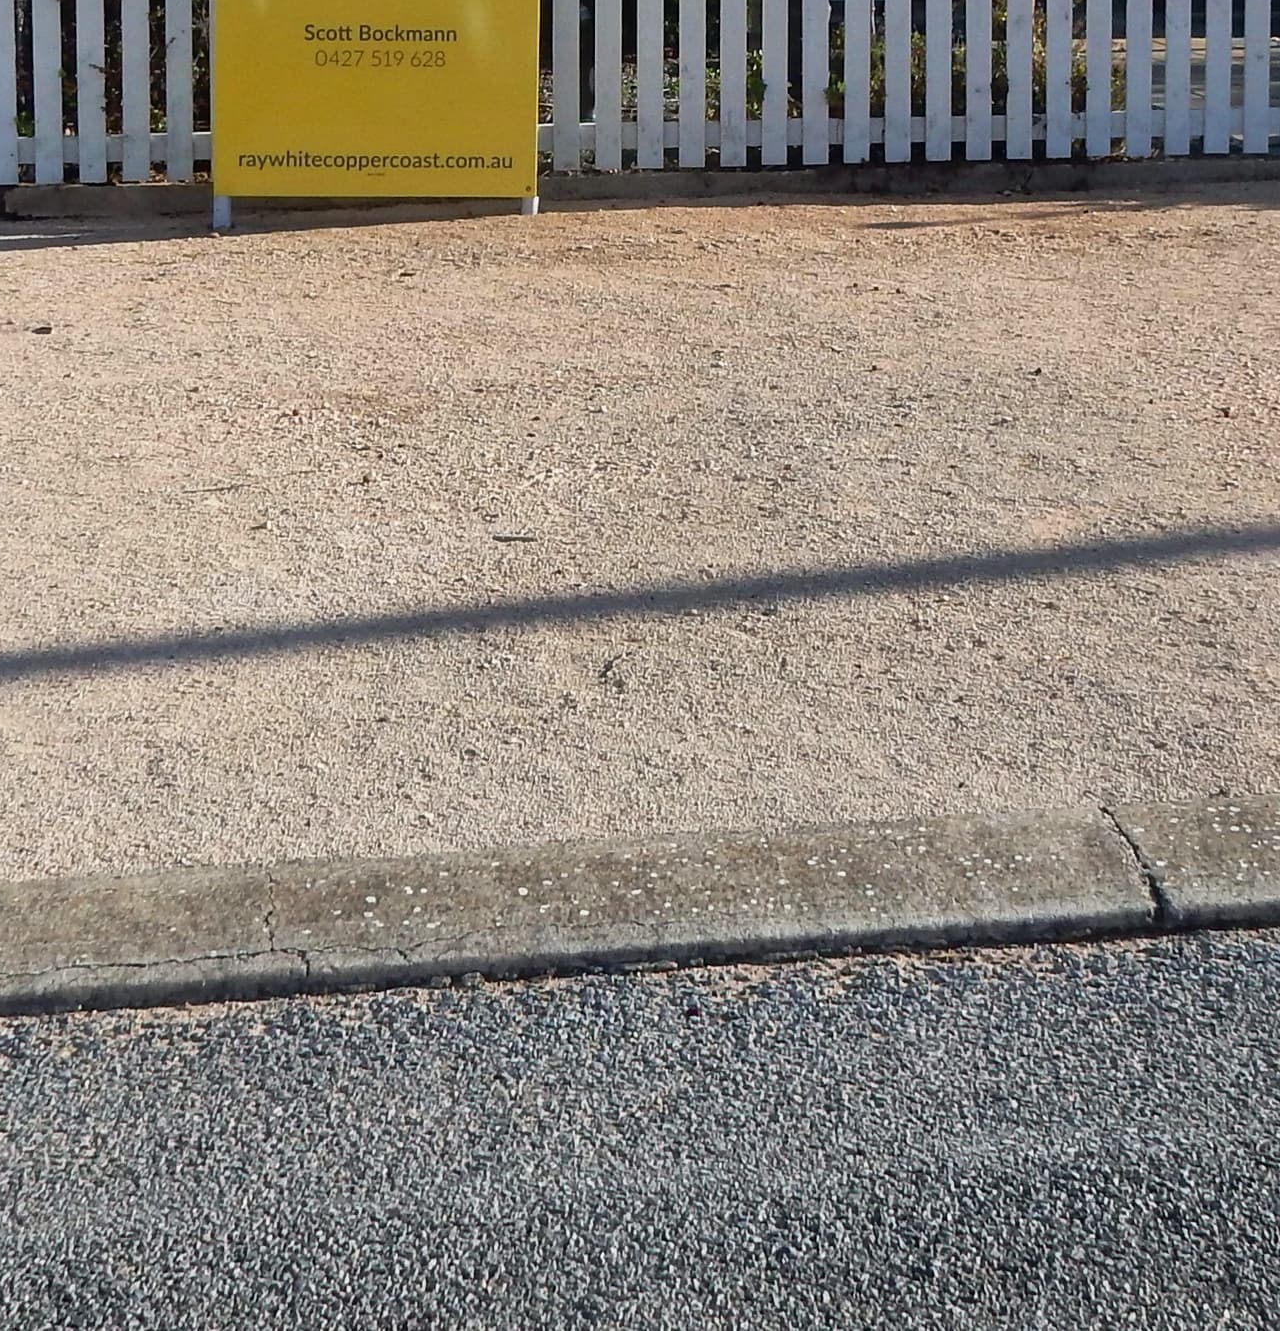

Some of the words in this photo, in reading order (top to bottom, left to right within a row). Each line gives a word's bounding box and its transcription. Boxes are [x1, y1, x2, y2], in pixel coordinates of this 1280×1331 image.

[304, 24, 352, 42] Scott
[359, 24, 457, 42] Bockmann
[315, 49, 364, 67] 0427
[371, 50, 405, 68] 519
[410, 50, 446, 68] 628
[238, 150, 513, 171] raywhitecoppercoast.com.au
